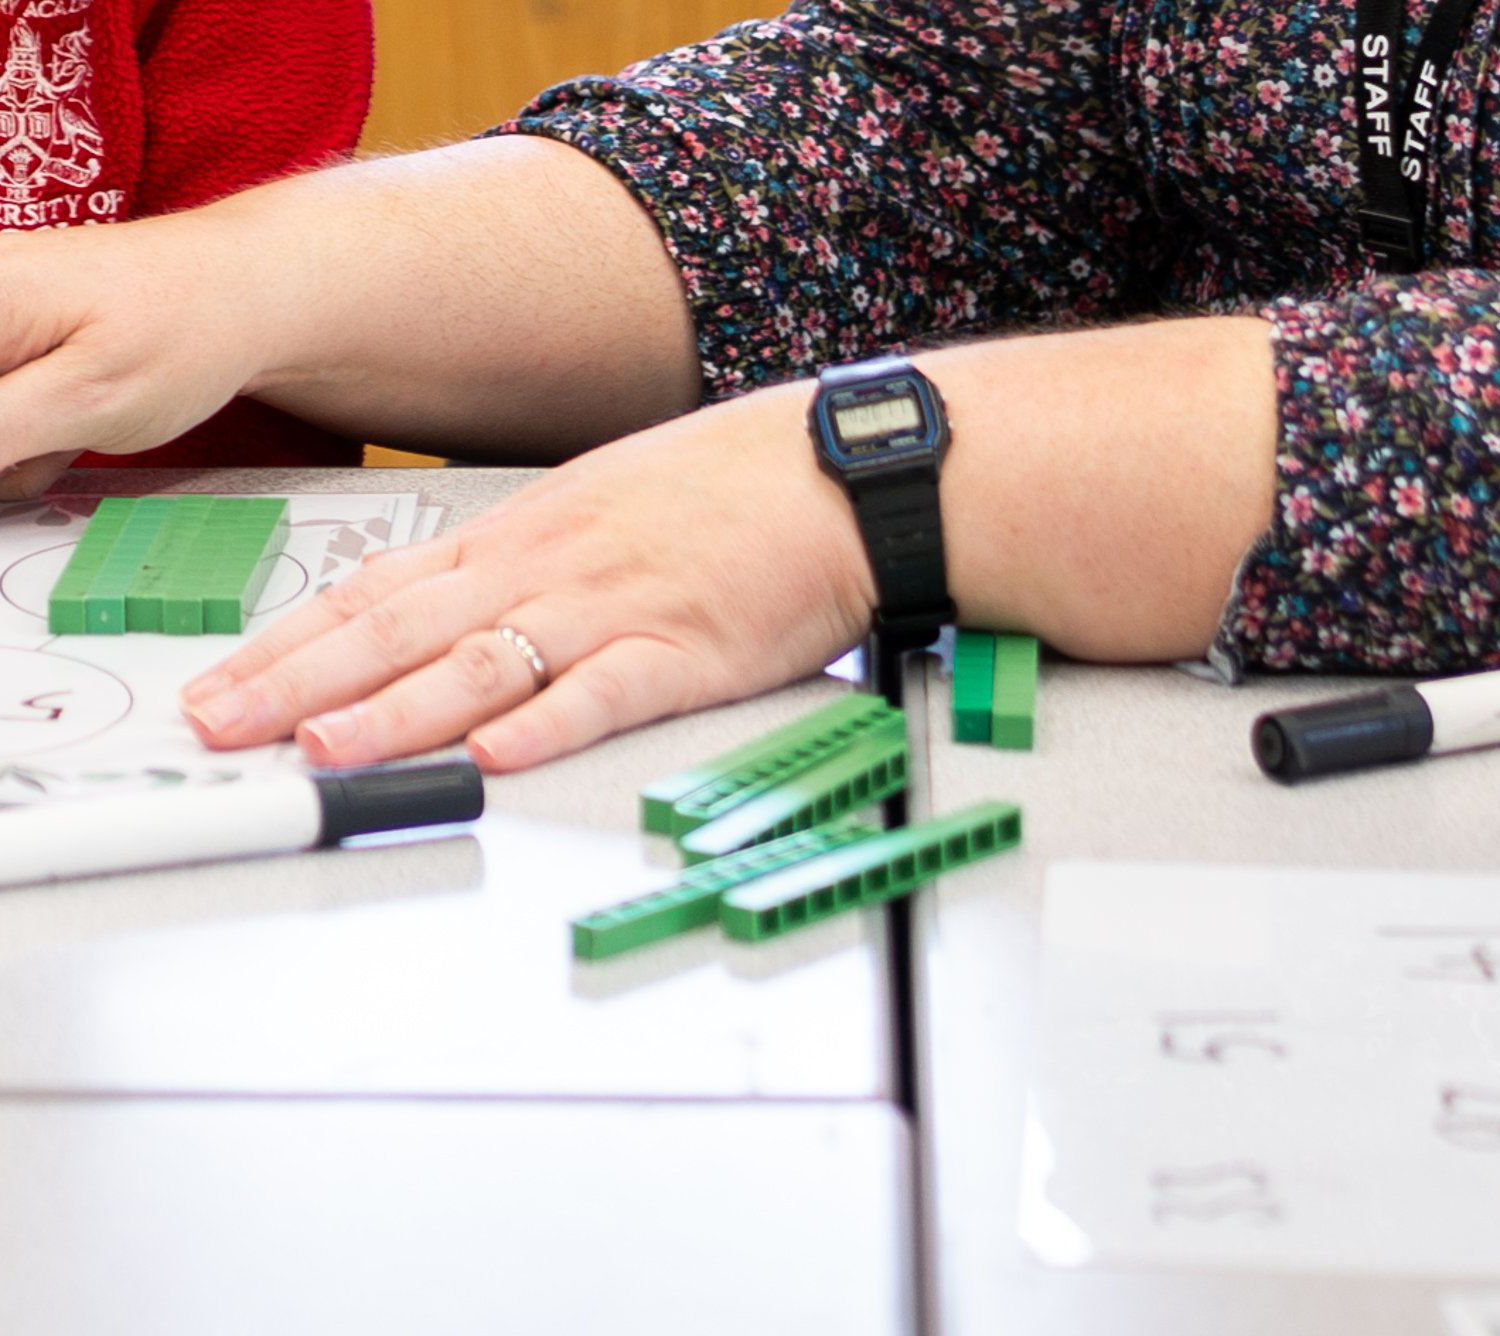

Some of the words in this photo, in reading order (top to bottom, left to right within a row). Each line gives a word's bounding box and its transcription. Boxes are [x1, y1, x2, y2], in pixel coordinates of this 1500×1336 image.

[1362, 32, 1392, 158] STAFF
[1400, 59, 1439, 182] STAFF
[87, 189, 126, 215] OF
